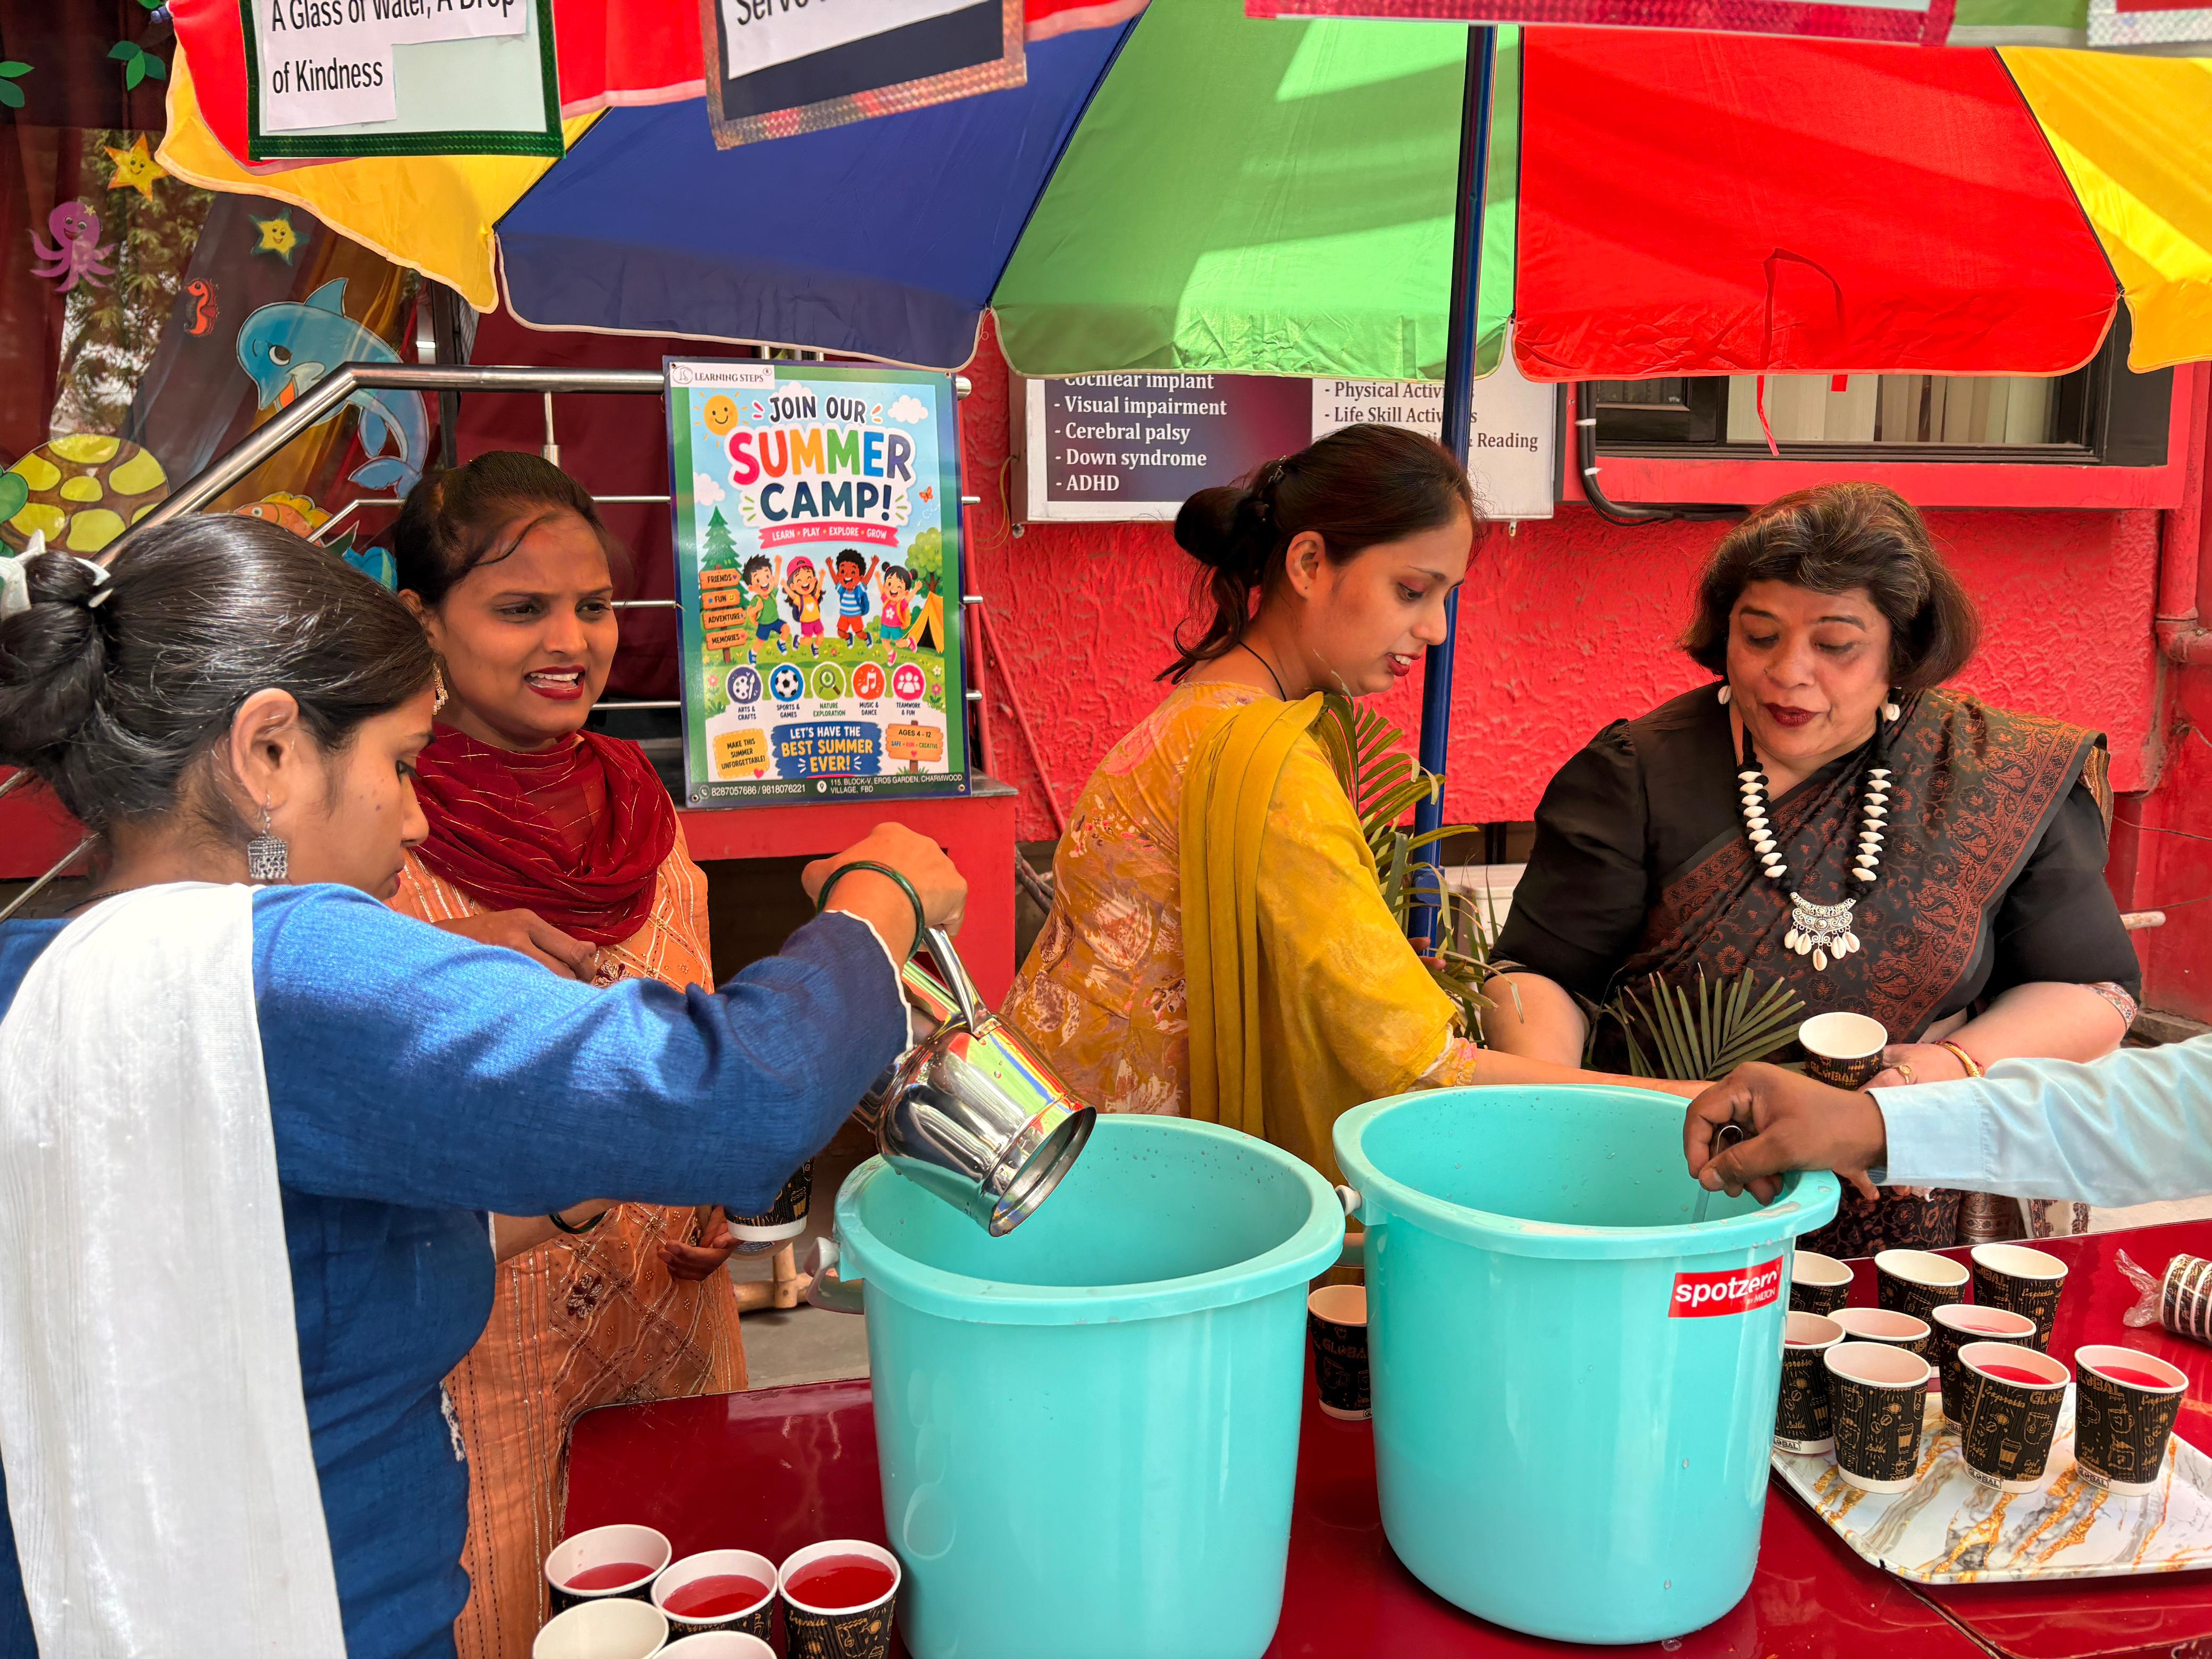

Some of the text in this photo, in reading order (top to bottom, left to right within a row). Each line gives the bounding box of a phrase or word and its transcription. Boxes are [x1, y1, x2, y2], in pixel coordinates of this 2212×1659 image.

[272, 0, 286, 31] A
[290, 0, 343, 29] Glass
[273, 57, 383, 94] of Kindness
[695, 373, 738, 382] LEARNING
[1146, 374, 1214, 392] implant
[1335, 382, 1398, 401] Physical
[1403, 383, 1474, 398] Activ
[770, 397, 866, 423] JOIN OUR
[1064, 396, 1119, 413] Visual
[1125, 397, 1227, 418] impairment
[1335, 407, 1363, 423] Life
[1368, 407, 1402, 423] Skill
[1406, 407, 1477, 423] Activs
[1066, 422, 1141, 440] Cerebral
[1145, 424, 1191, 445] palsy
[1478, 433, 1538, 451] Reading
[728, 429, 911, 485] SUMMER
[1066, 449, 1117, 465] Down
[1121, 449, 1206, 470] syndrome
[1066, 475, 1120, 491] ADHD
[760, 482, 891, 521] CAMP!
[772, 526, 887, 541] LEARN PLAY EXPLORE GROW
[707, 574, 732, 583] FRIENDS
[715, 595, 726, 604] FUN
[708, 613, 740, 623] ADVENTURE
[712, 634, 740, 644] MEMORIES
[790, 726, 861, 739] LET'S HAVE THE
[731, 748, 753, 758] SUMMER
[781, 739, 873, 757] BEST SUMMER
[721, 756, 766, 769] UNFORGETTABLE!
[810, 756, 850, 772] EVER!
[761, 784, 806, 794] 9818076221
[1754, 1287, 1775, 1303] MILTON
[1322, 1338, 1367, 1359] GLOBA
